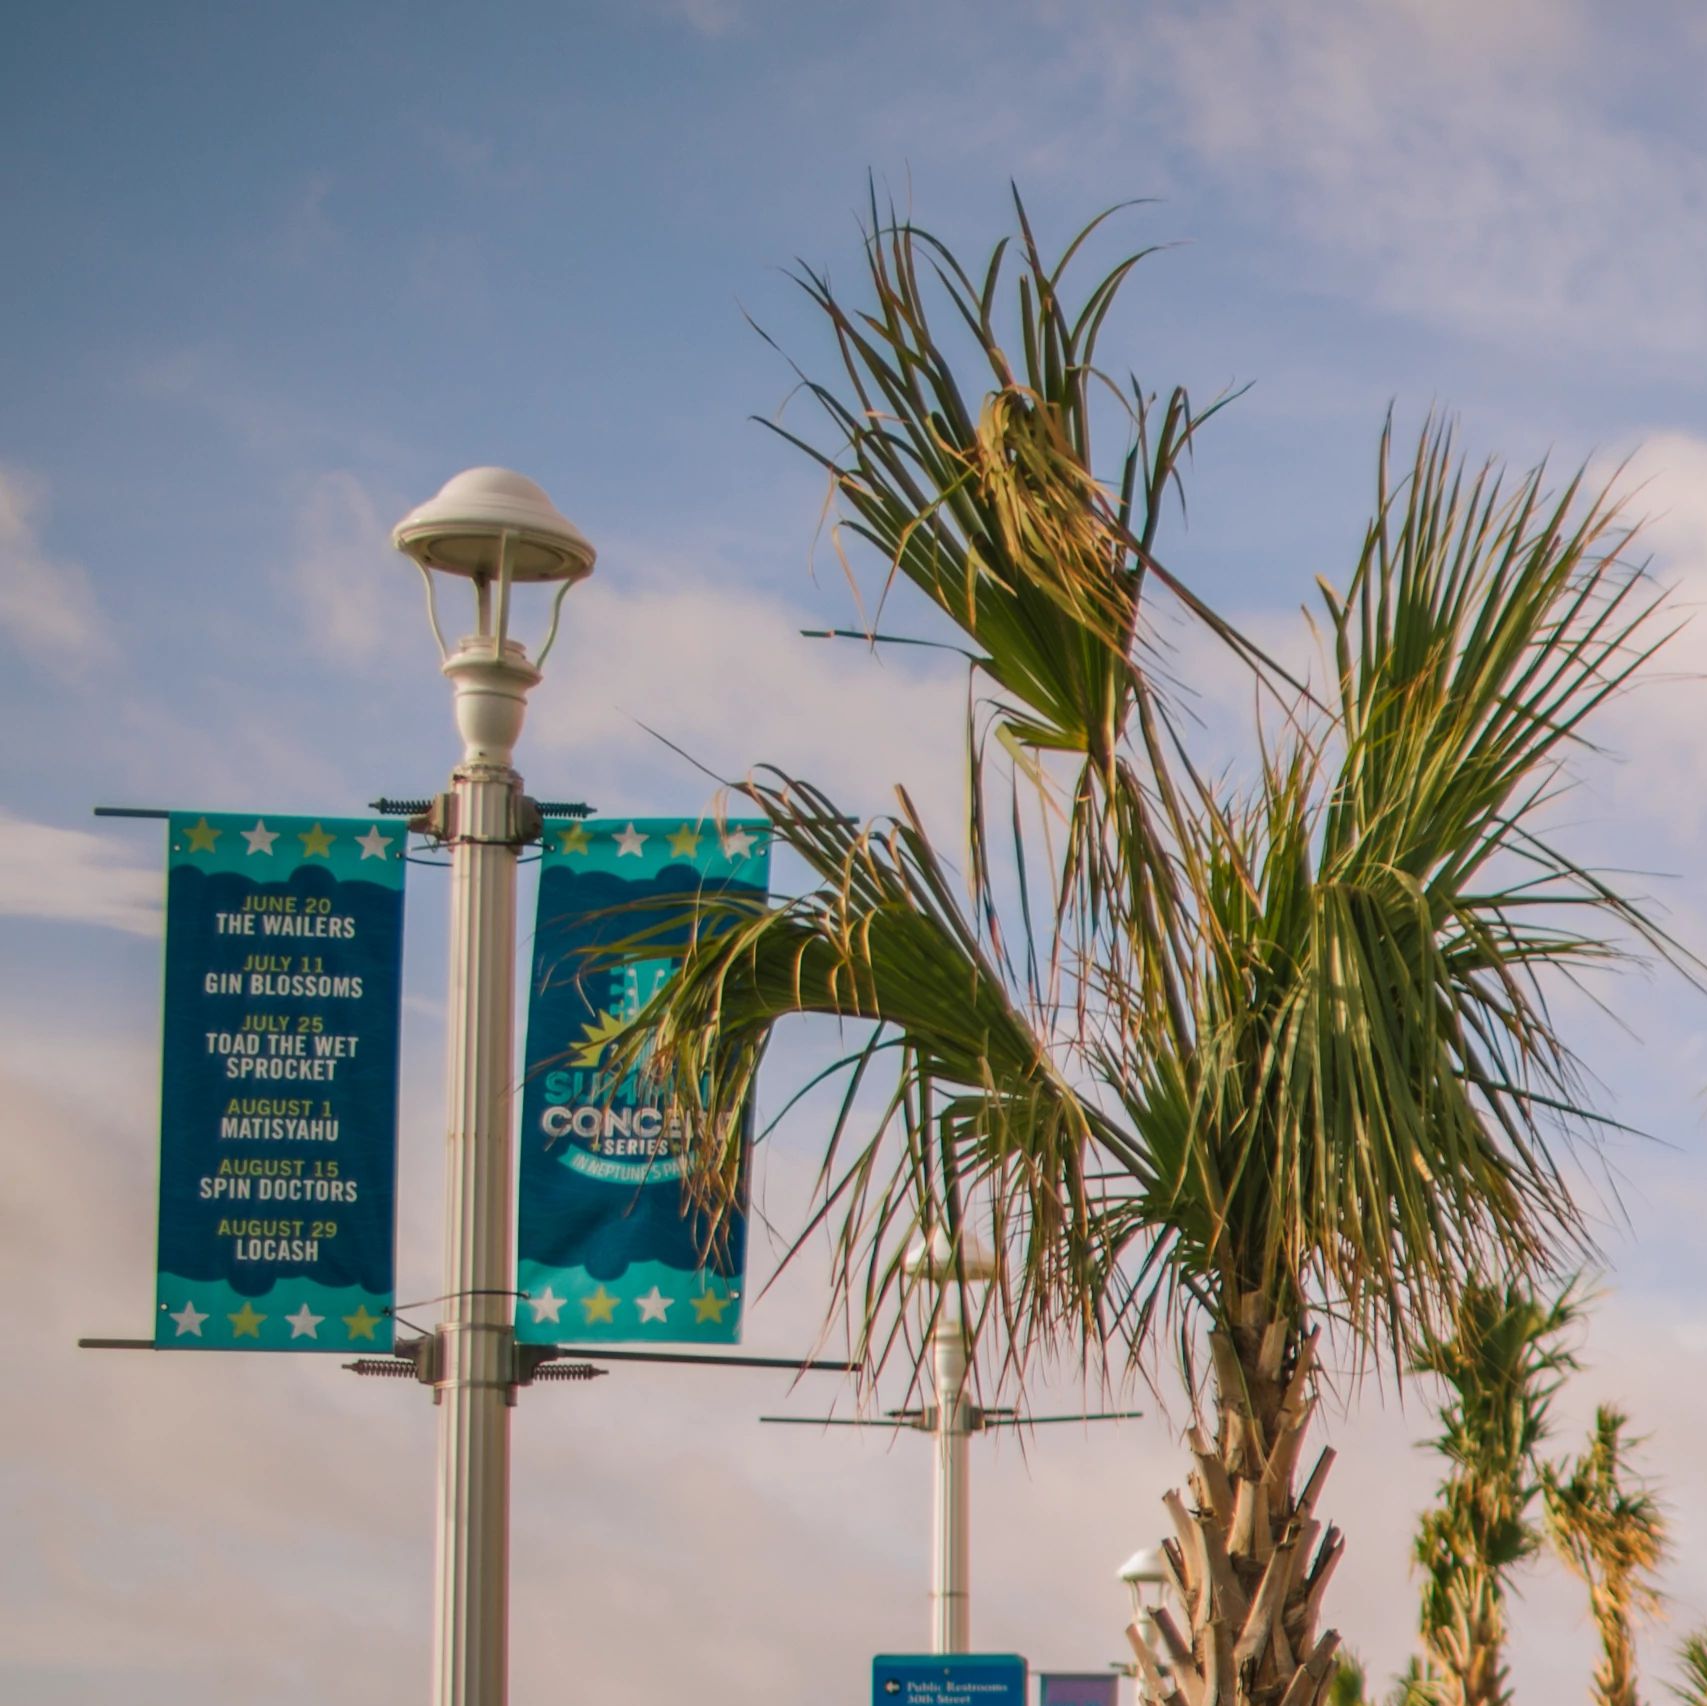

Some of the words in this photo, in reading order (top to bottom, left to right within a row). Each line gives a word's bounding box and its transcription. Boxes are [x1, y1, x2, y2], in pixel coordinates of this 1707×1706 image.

[242, 895, 298, 913] JUNE
[305, 897, 332, 915] 20
[216, 913, 256, 935] THE
[262, 914, 356, 939] WAILERS
[244, 954, 292, 972] JULY
[301, 956, 324, 973] 11
[204, 972, 243, 995] GIN
[250, 973, 364, 998] BLOSSOMS
[242, 1015, 290, 1032] JULY
[297, 1016, 324, 1033] 25
[205, 1032, 260, 1054] TOAD
[267, 1034, 306, 1057] THE
[314, 1035, 359, 1058] WET
[226, 1056, 337, 1081] SPROCKET
[227, 1098, 314, 1117] AUGUST
[322, 1100, 332, 1118] 1
[221, 1116, 339, 1142] MATISYAHU
[604, 1138, 669, 1156] SERIES
[218, 1158, 305, 1177] AUGUST
[314, 1160, 340, 1178] 15
[572, 1152, 588, 1170] IN
[199, 1177, 251, 1200] SPIN
[258, 1178, 358, 1203] DOCTORS
[218, 1219, 305, 1238] AUGUST
[311, 1221, 338, 1239] 29
[236, 1239, 319, 1262] LOCASH
[946, 1680, 1008, 1693] Restrooms
[937, 1693, 971, 1705] Street
